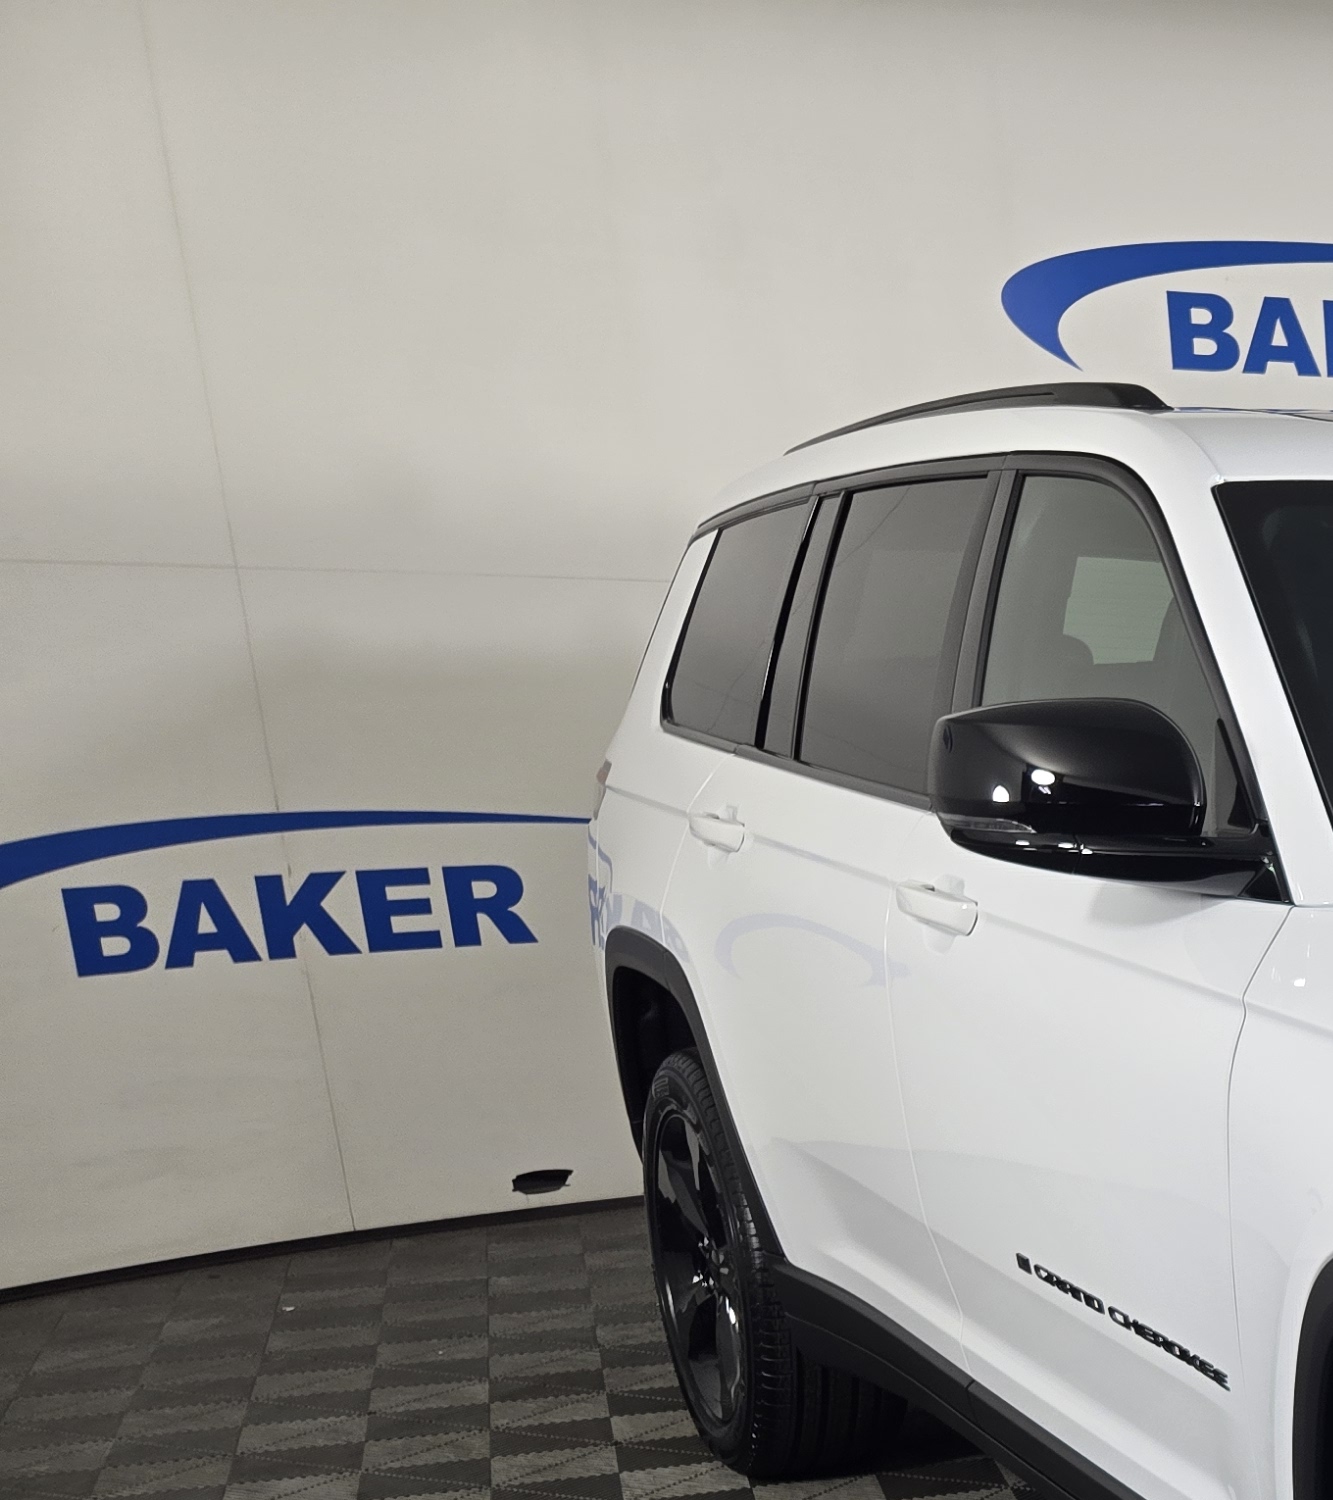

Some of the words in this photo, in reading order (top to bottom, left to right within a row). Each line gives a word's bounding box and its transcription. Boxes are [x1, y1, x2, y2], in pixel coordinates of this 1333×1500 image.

[61, 864, 539, 977] BAKER
[1033, 1263, 1106, 1316] GRAND
[1107, 1305, 1232, 1393] CHEROKEE
